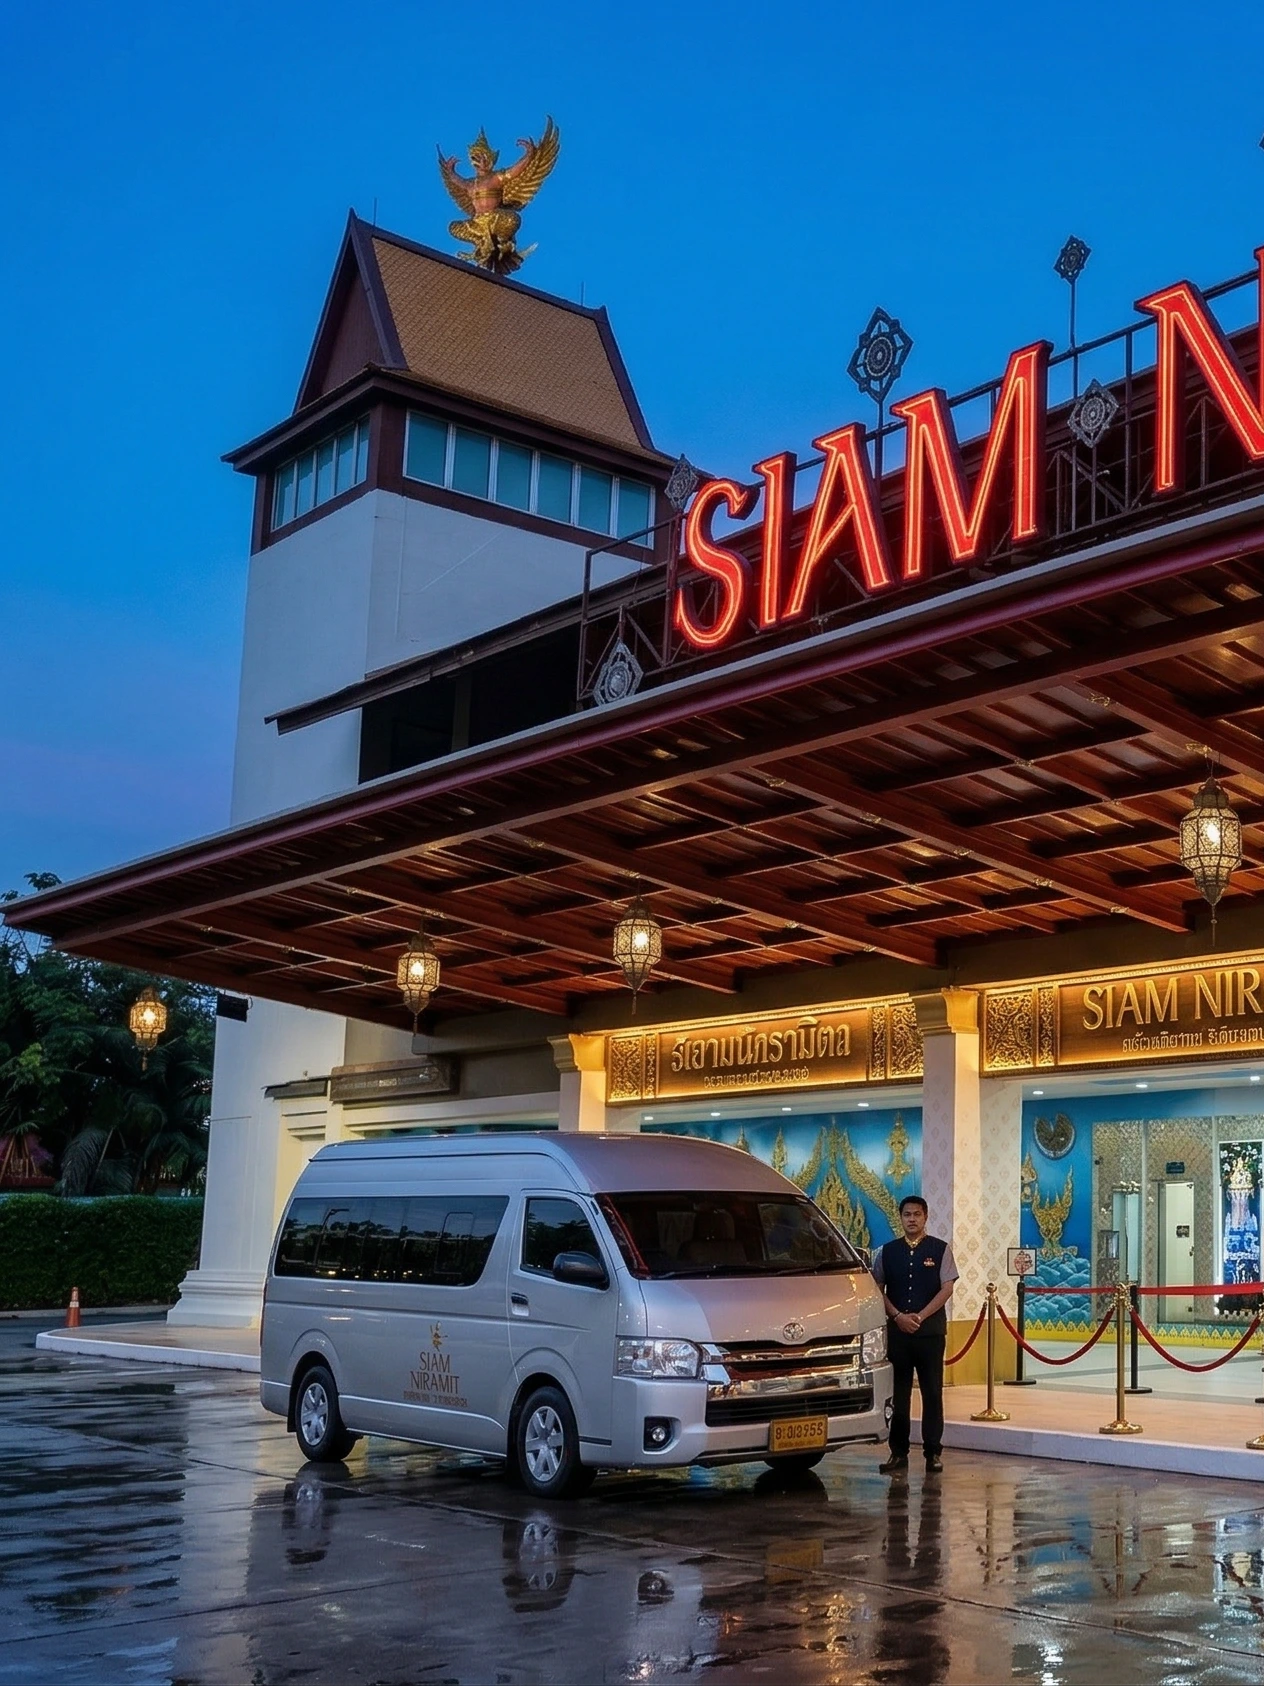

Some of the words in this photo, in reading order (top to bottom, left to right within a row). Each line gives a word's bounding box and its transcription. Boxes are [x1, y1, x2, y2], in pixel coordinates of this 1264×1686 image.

[673, 340, 1052, 649] SIAM
[1082, 975, 1179, 1031] SIAM
[419, 1351, 451, 1373] SIAM
[410, 1371, 460, 1394] NIRAMIT
